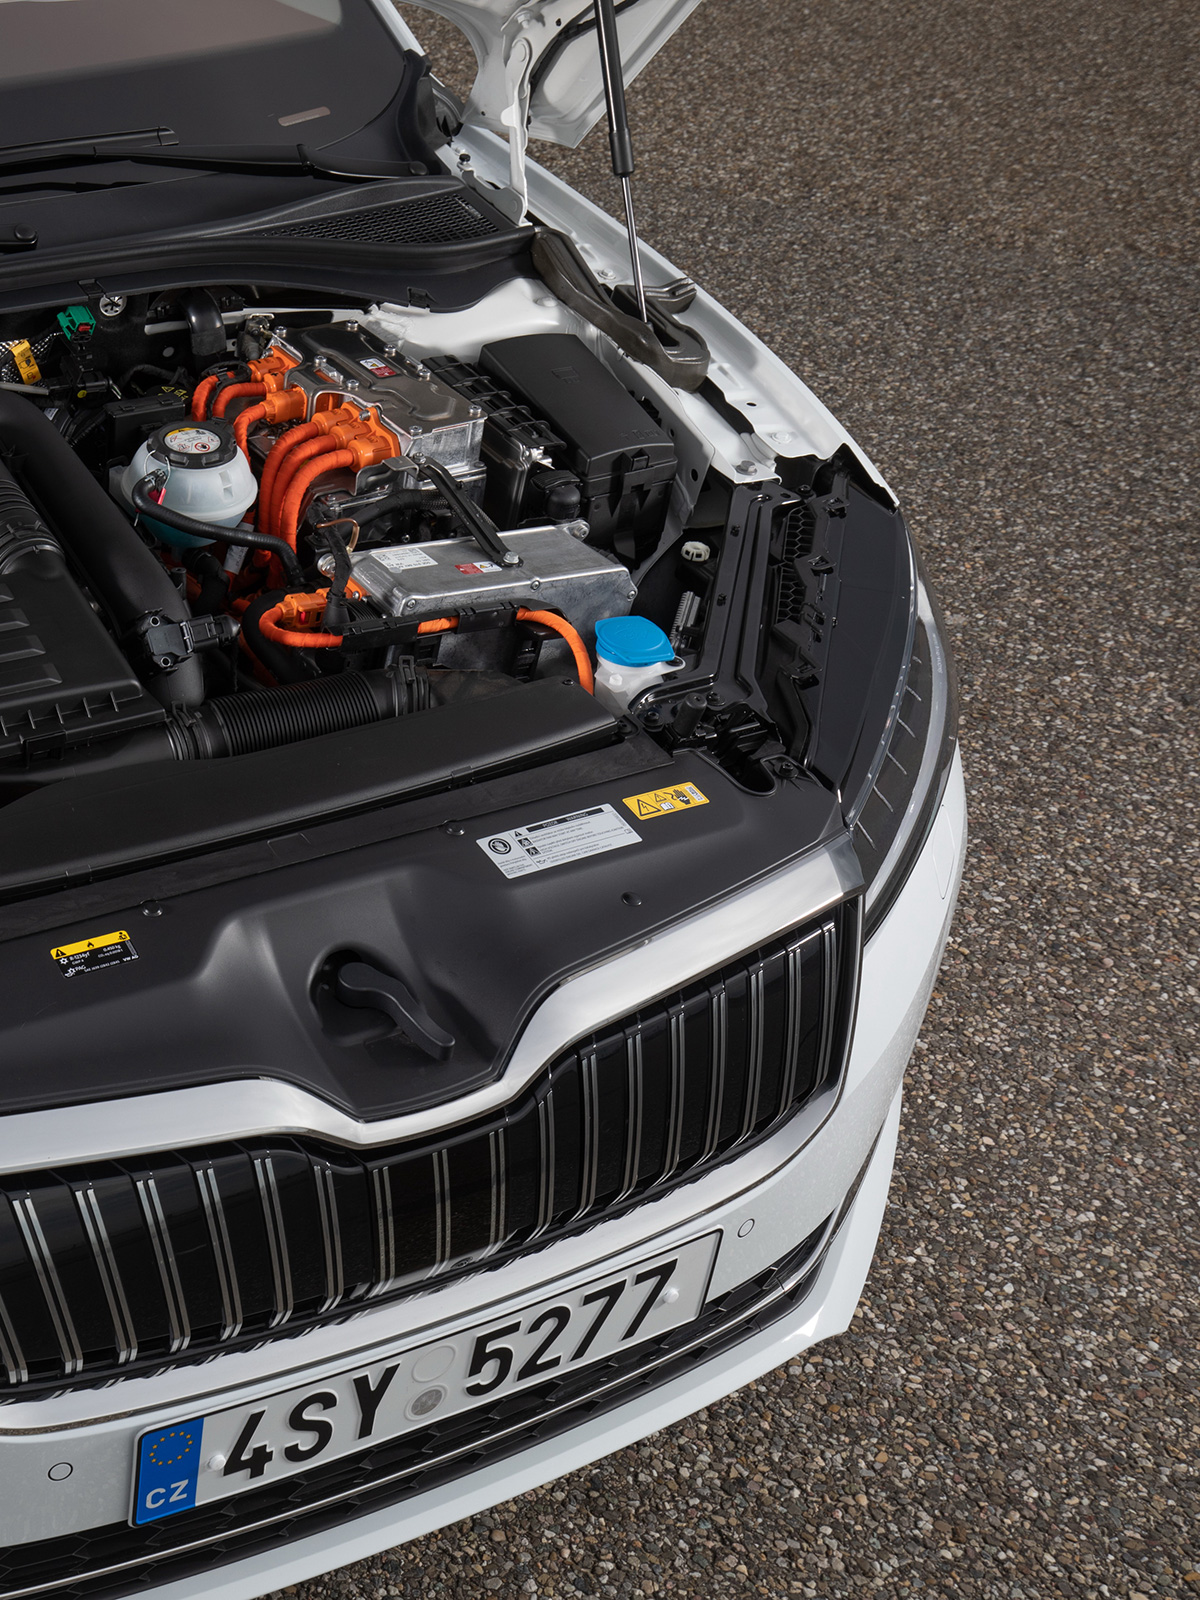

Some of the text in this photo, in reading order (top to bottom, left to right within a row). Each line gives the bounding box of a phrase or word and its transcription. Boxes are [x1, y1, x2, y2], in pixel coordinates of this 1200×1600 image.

[566, 812, 588, 821] WARNING
[222, 1258, 678, 1480] 4SY 5277
[145, 1479, 189, 1510] CZ
